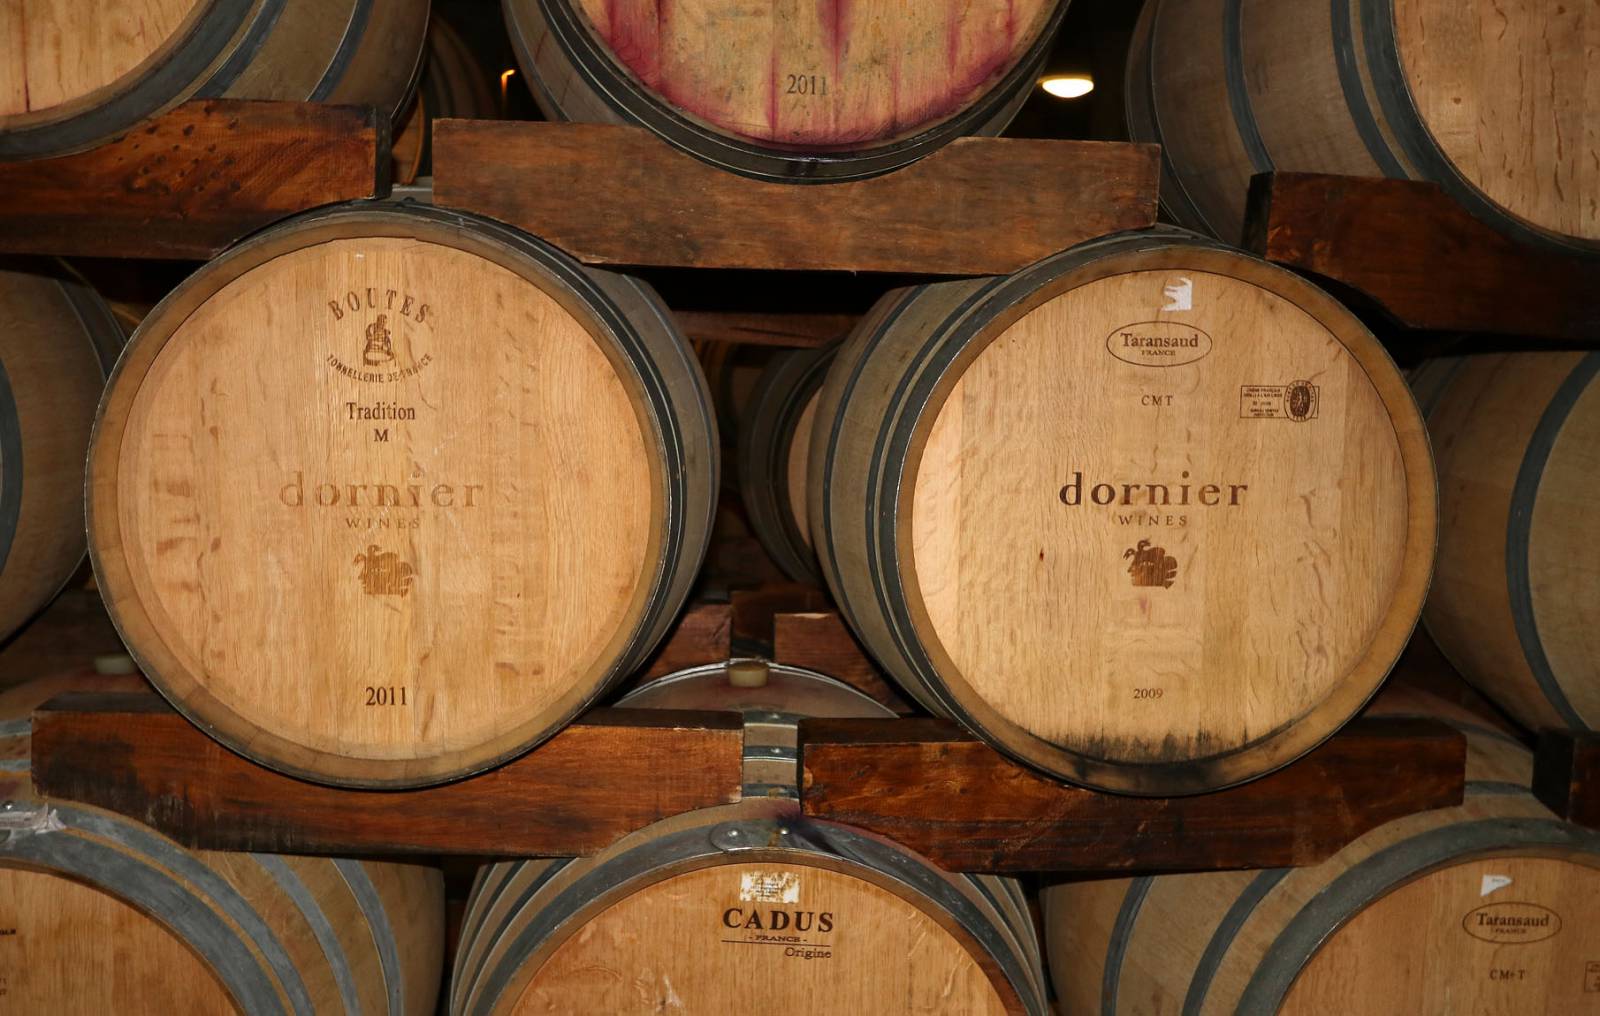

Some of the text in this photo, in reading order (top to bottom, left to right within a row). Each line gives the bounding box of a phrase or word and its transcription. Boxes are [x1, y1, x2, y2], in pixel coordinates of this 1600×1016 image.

[786, 74, 828, 96] 2011
[328, 287, 430, 324] BOUTES
[1120, 332, 1199, 348] Taransaud
[346, 402, 416, 421] Tradition
[373, 428, 390, 442] M
[279, 470, 484, 508] dornier
[1059, 470, 1248, 507] dornier
[345, 517, 421, 529] WINES
[1118, 515, 1188, 527] WINES
[365, 686, 408, 706] 2011
[1133, 688, 1164, 700] 2009
[722, 907, 833, 933] CADUS
[1476, 911, 1550, 928] Taransaud
[784, 946, 832, 959] Origine
